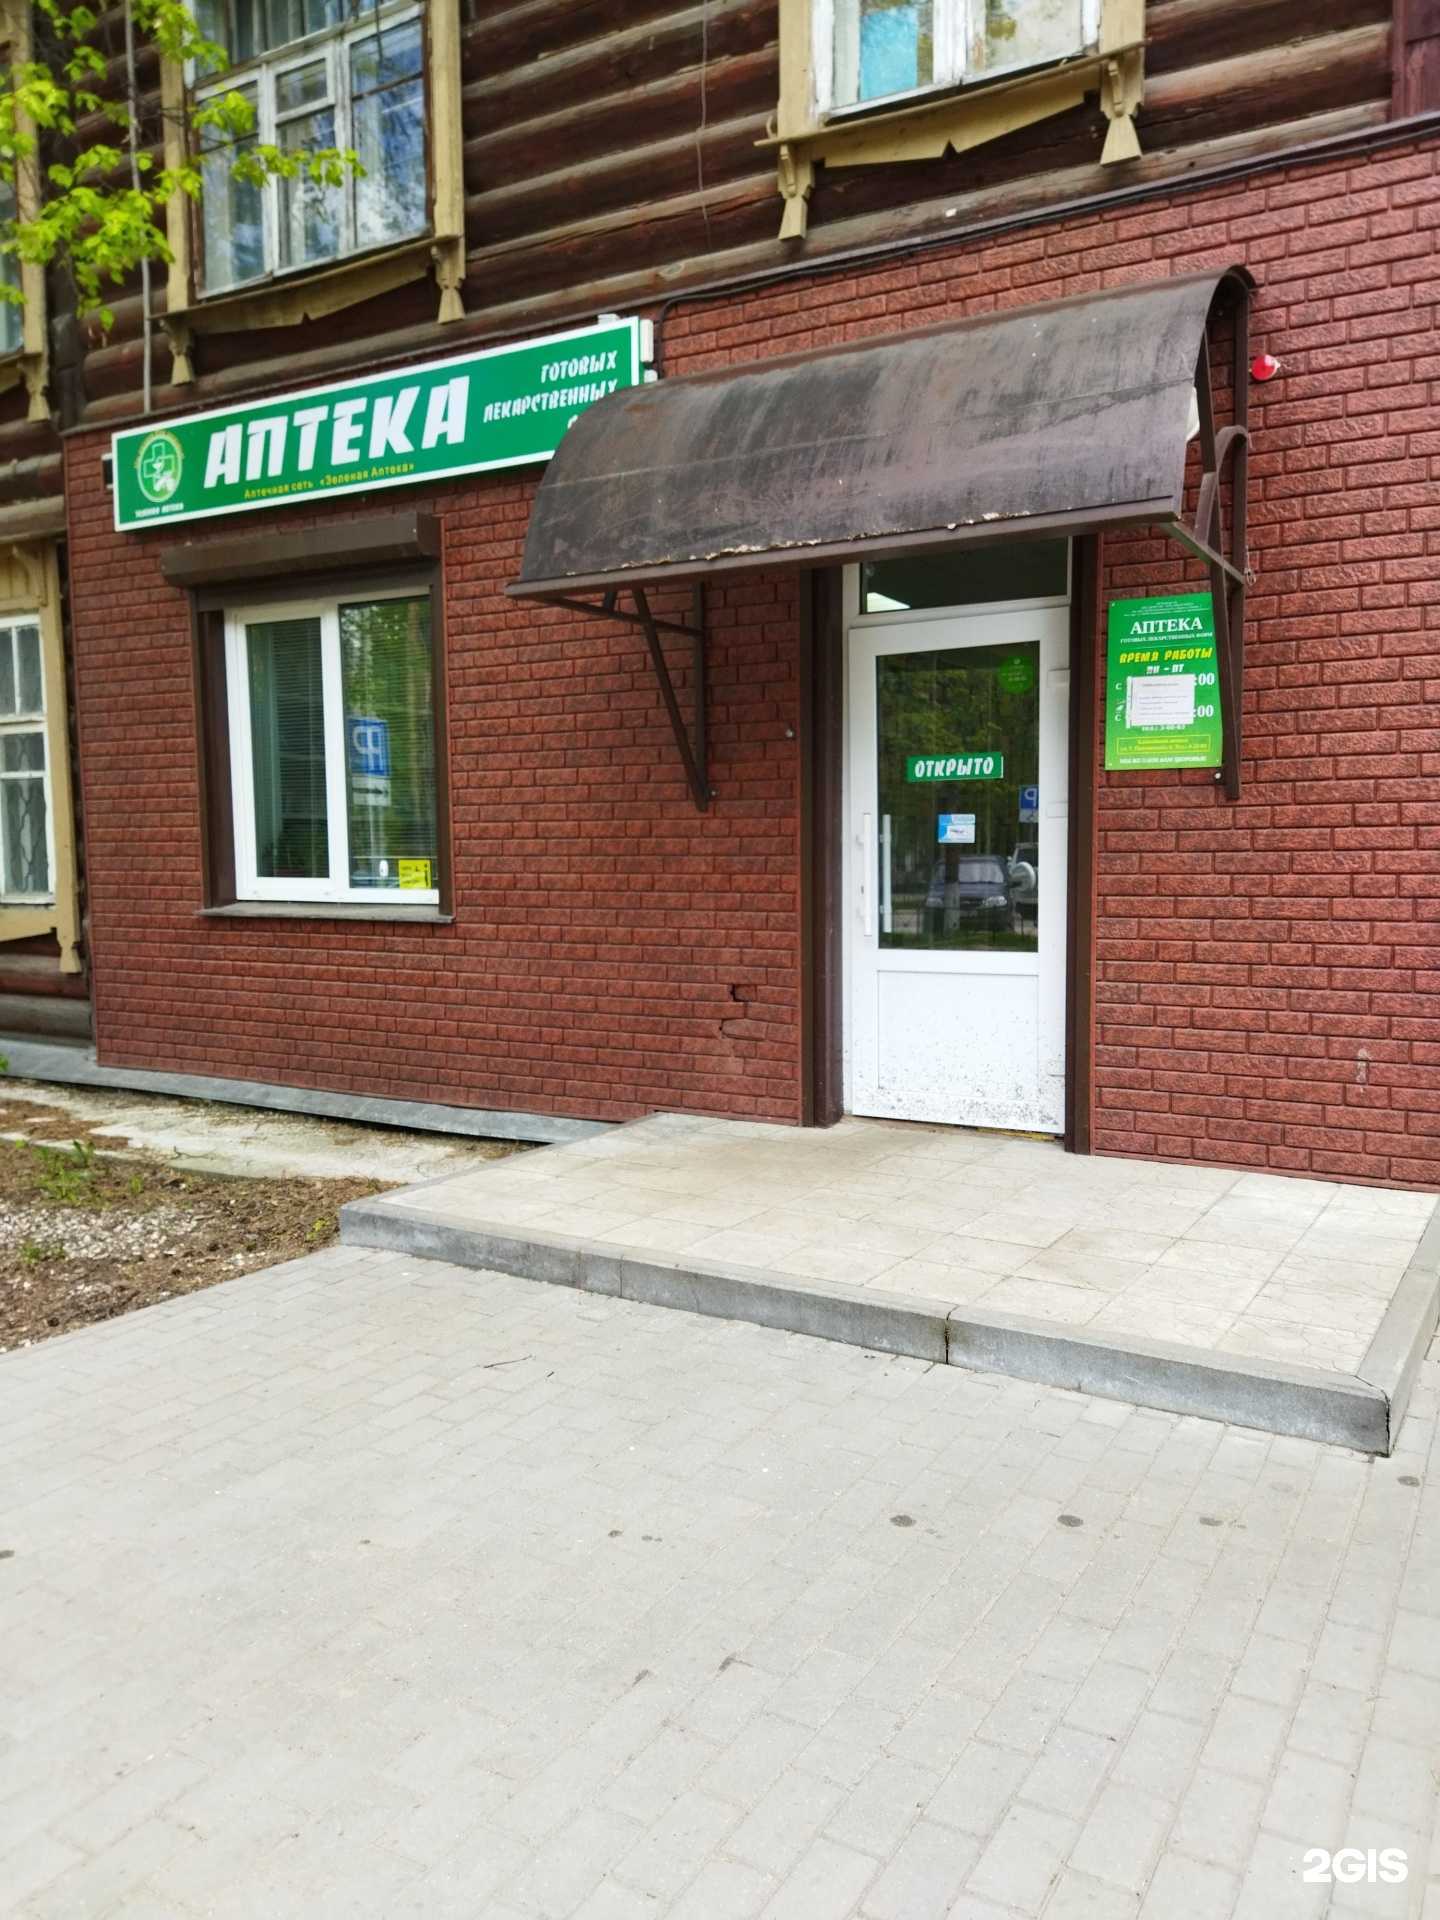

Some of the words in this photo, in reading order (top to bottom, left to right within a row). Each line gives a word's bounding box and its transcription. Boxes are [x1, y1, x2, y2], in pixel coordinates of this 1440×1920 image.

[541, 350, 617, 383] ГОТОВЫХ
[203, 376, 469, 488] АПТЕКА
[1130, 617, 1203, 635] АПТЕКА
[1119, 651, 1159, 664] ВРЕМЯ
[1164, 647, 1213, 661] РАБОТЫ
[914, 756, 994, 779] ОТКРЫТО
